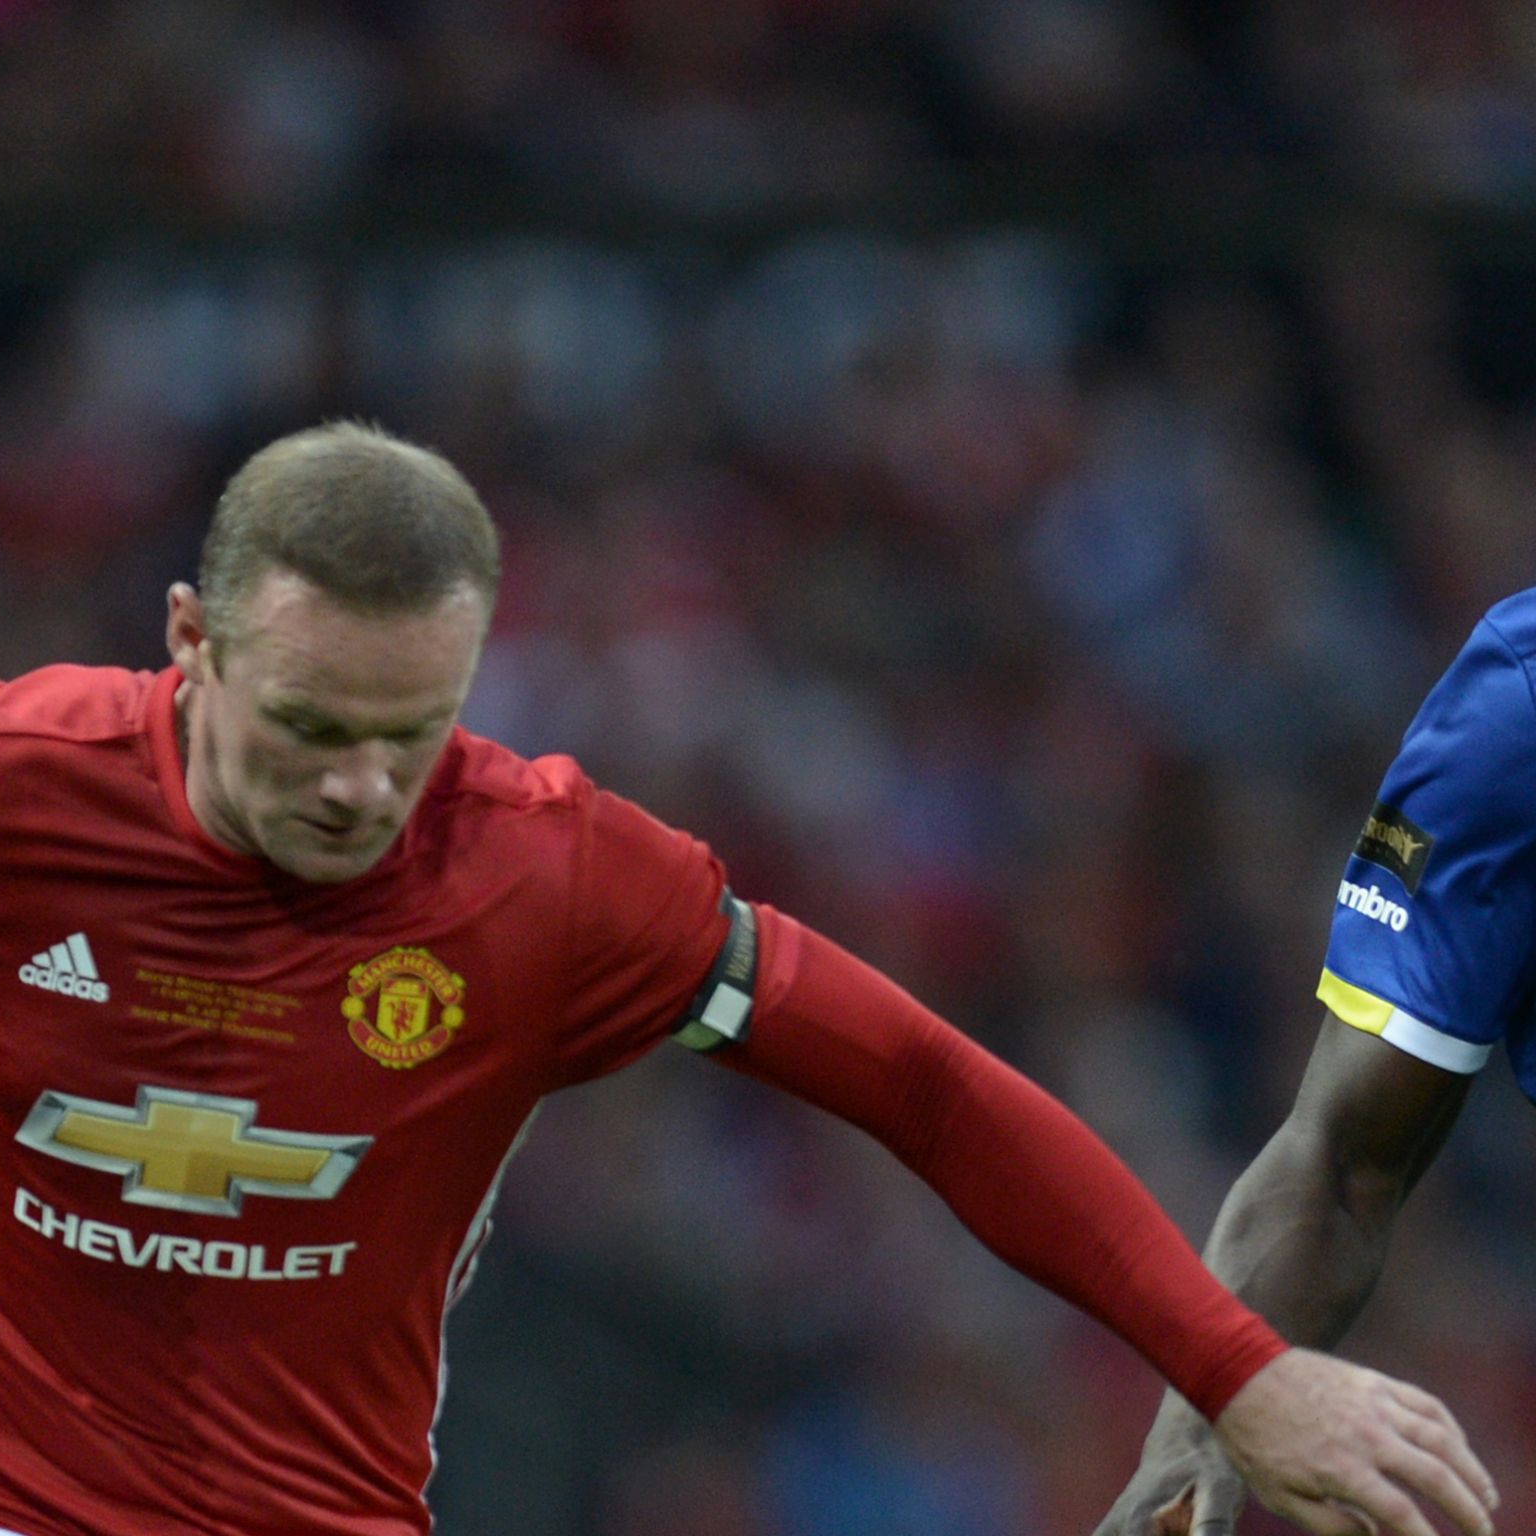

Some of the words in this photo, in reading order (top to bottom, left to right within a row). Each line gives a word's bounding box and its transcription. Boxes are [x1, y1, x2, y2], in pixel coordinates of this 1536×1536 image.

[18, 957, 110, 1004] adidas
[358, 953, 453, 998] MANCHESTER
[366, 1035, 433, 1058] UNITED
[14, 1186, 357, 1281] CHEVROLET
